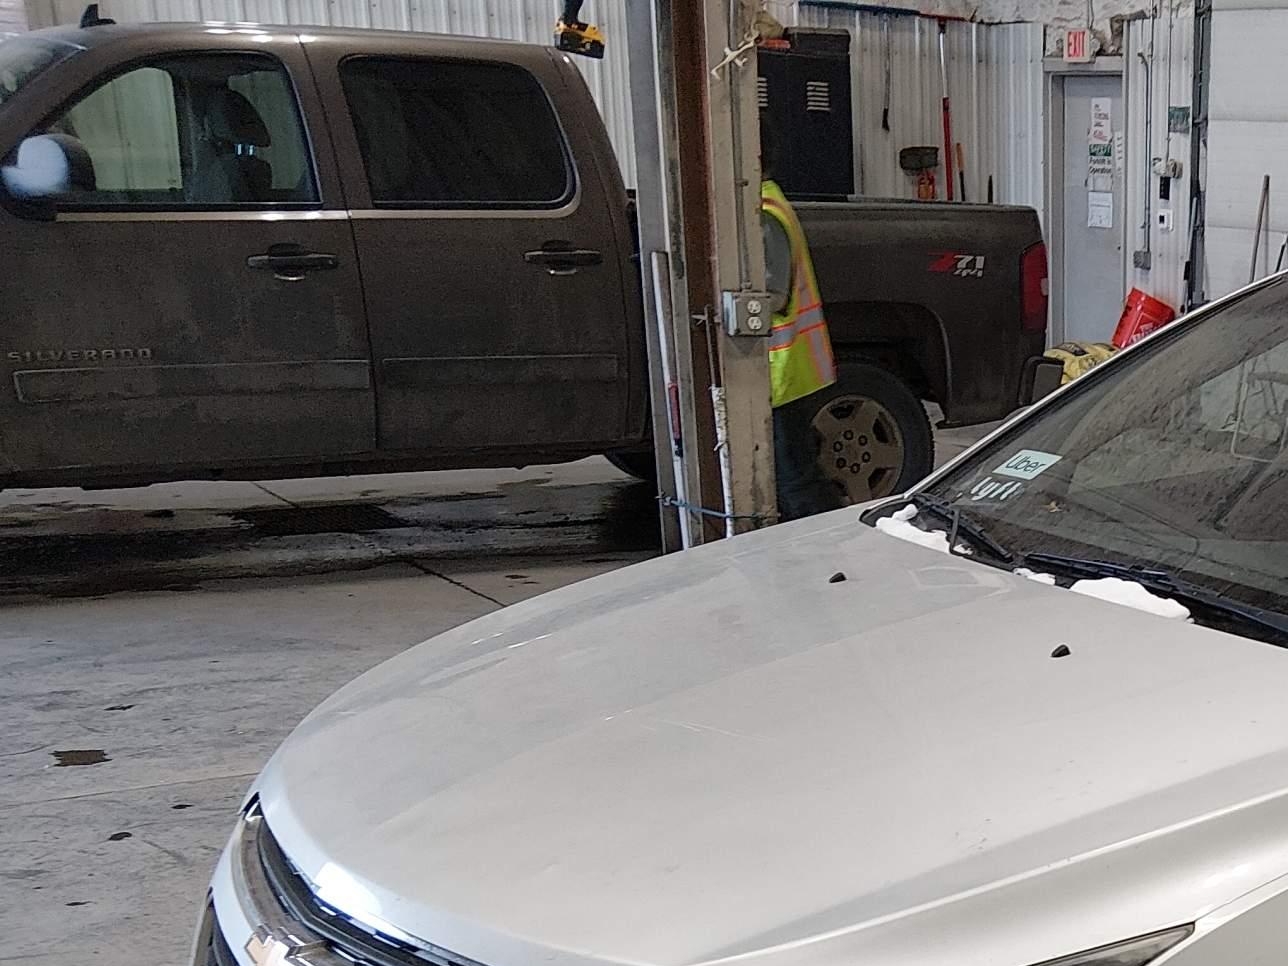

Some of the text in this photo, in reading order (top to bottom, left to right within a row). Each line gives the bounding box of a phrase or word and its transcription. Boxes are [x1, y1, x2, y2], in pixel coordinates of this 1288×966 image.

[1067, 31, 1086, 57] EXIT
[928, 250, 985, 270] Z71
[7, 348, 152, 362] SILVERADO
[1005, 454, 1047, 473] Uber
[970, 476, 1022, 501] lyft
